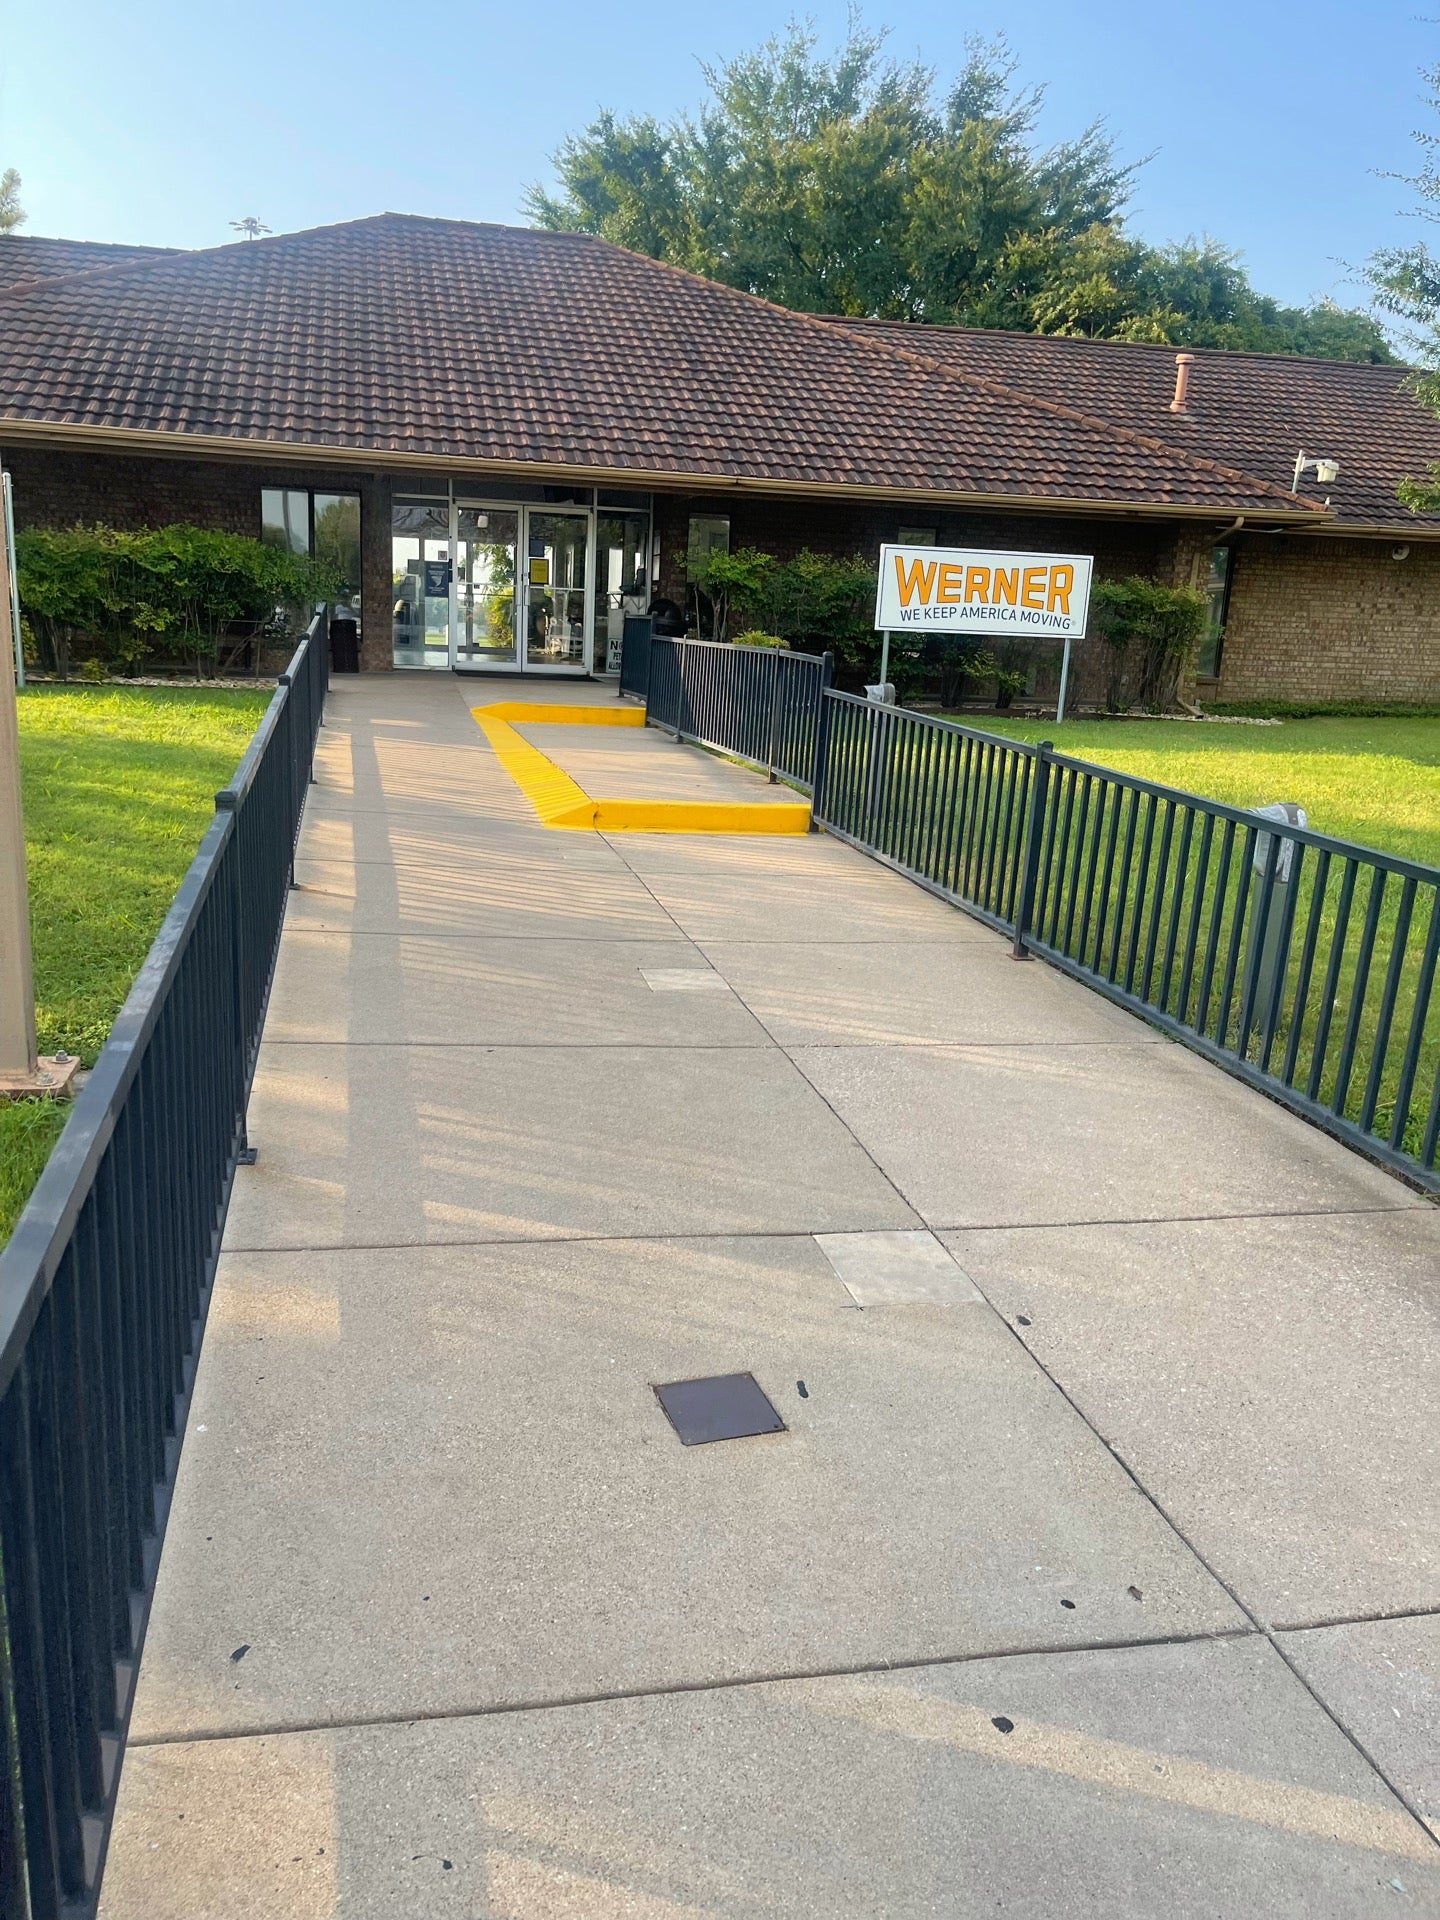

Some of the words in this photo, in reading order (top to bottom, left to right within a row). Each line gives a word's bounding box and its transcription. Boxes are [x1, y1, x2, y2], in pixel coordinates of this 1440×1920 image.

[895, 555, 1074, 615] WERNER
[900, 608, 920, 621] WE
[924, 606, 957, 619] KEEP
[960, 606, 1017, 621] AMERICA
[1020, 611, 1071, 630] MOVING
